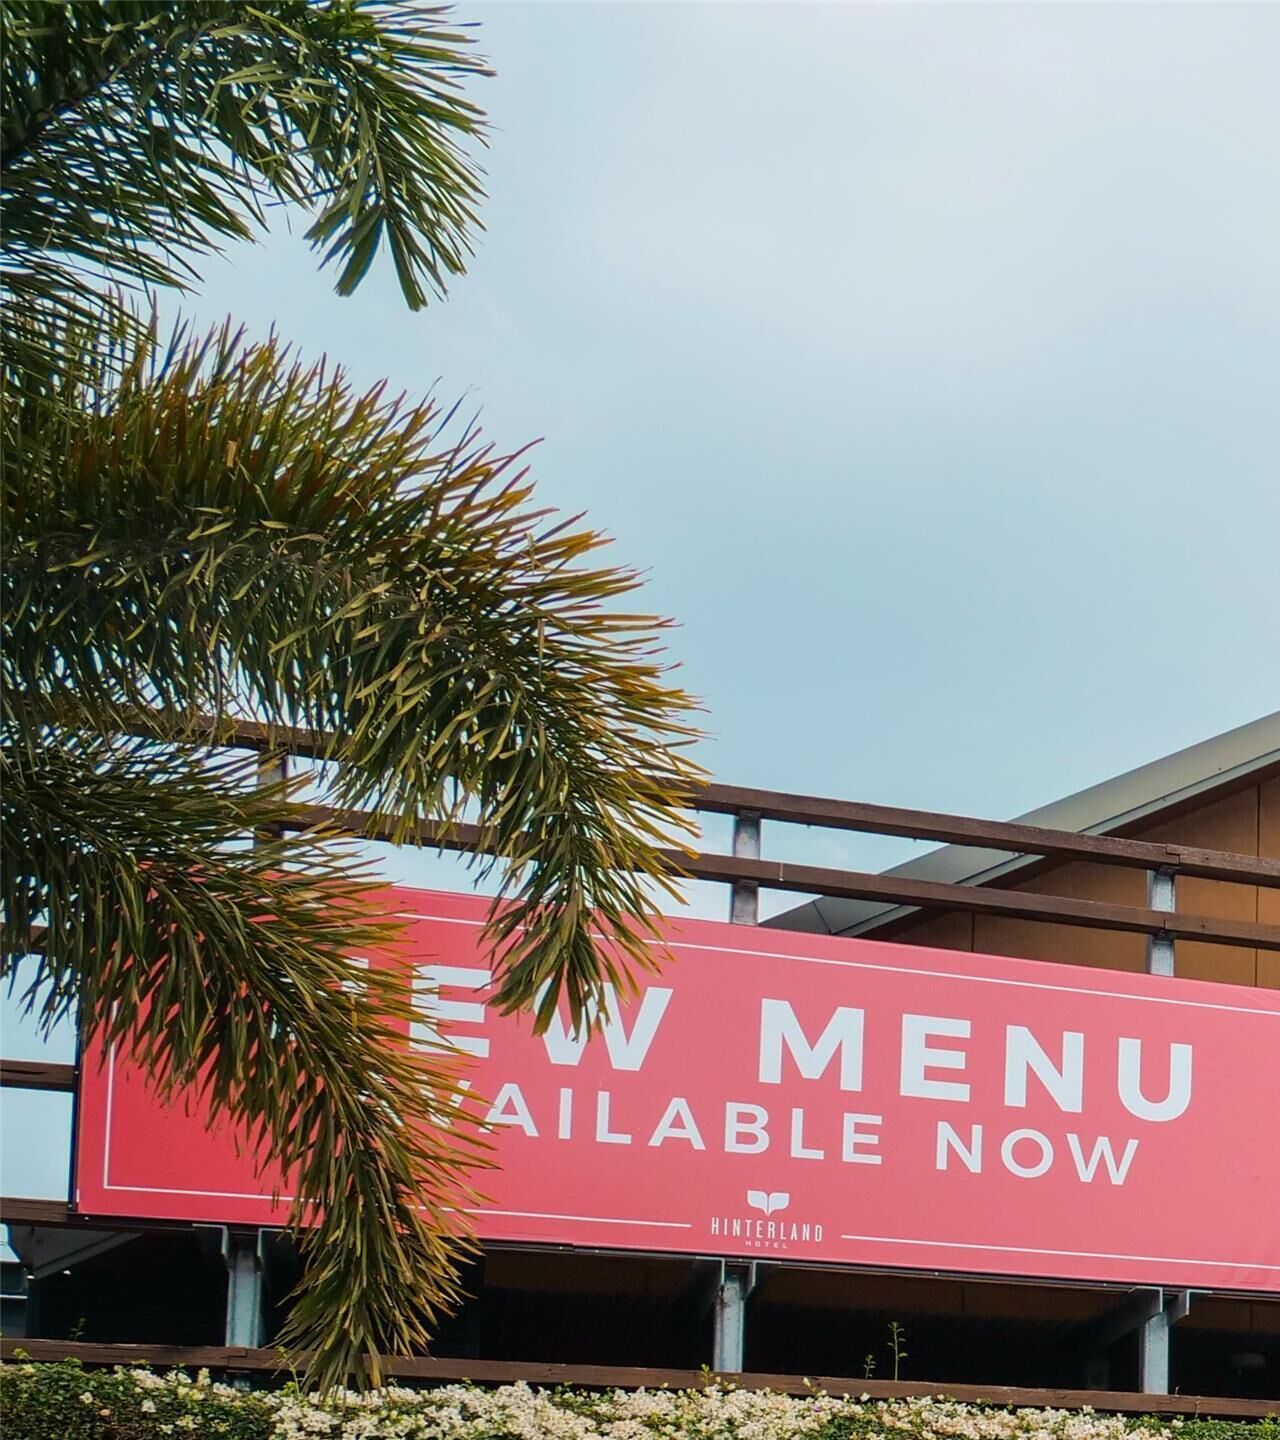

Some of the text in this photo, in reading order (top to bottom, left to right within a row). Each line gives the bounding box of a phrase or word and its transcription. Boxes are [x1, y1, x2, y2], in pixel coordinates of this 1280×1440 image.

[758, 998, 1193, 1122] MENU
[936, 1123, 1139, 1185] NOW
[711, 1217, 823, 1242] HINTERLAND
[745, 1240, 788, 1249] HOTEL
